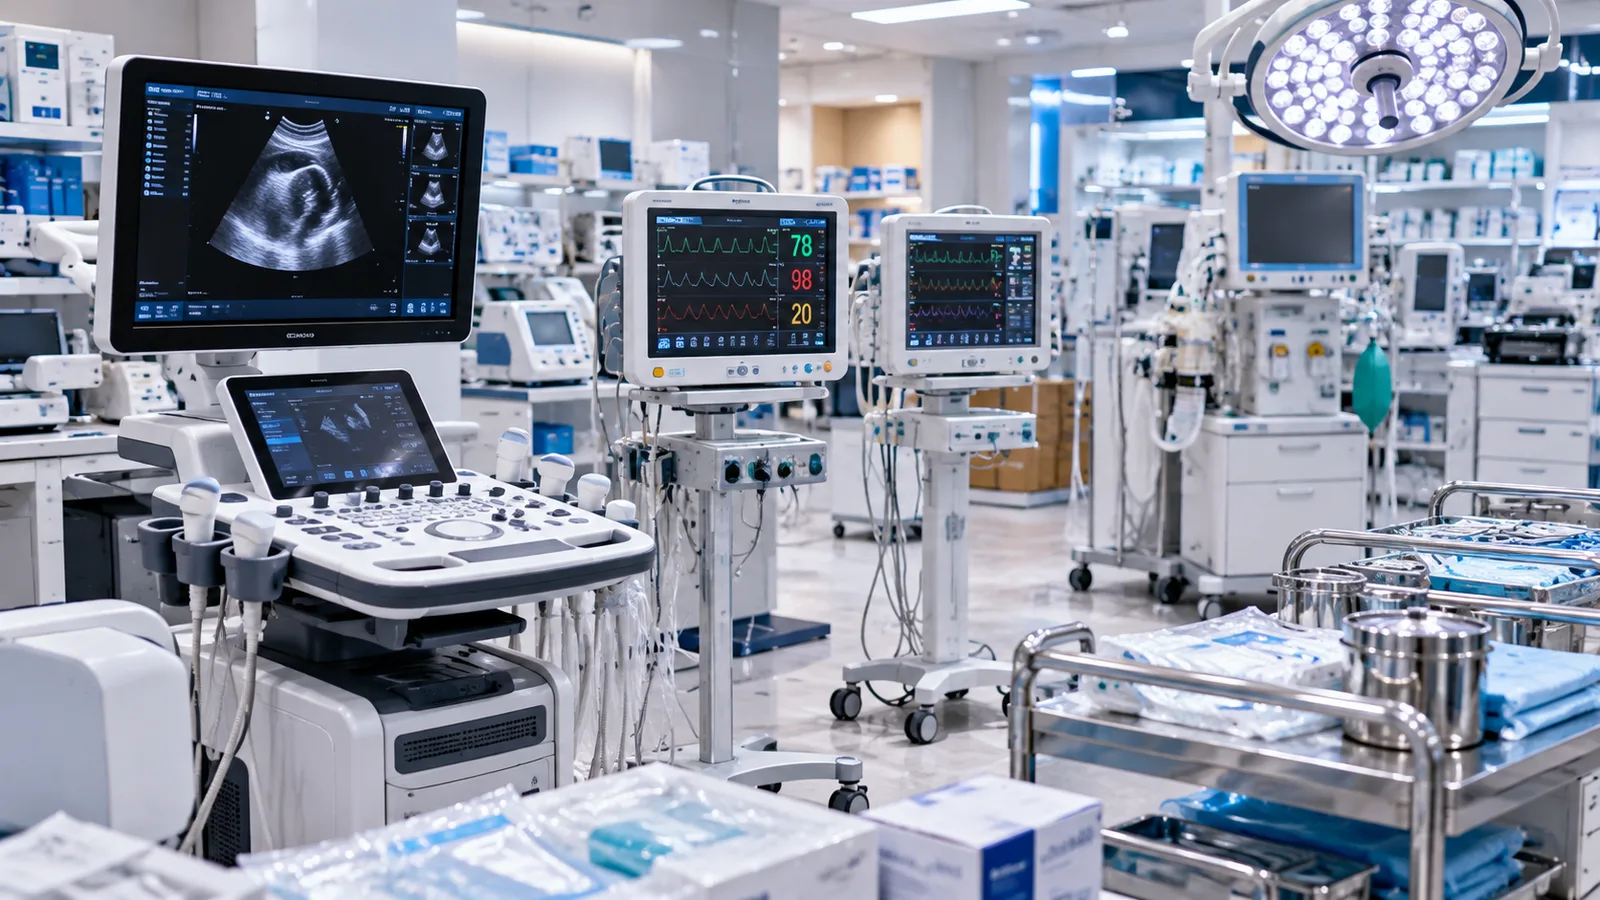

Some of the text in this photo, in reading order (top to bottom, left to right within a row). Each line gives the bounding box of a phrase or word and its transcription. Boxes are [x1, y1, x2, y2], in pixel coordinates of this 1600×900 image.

[790, 234, 813, 257] 78
[791, 269, 812, 291] 98
[791, 303, 812, 325] 20
